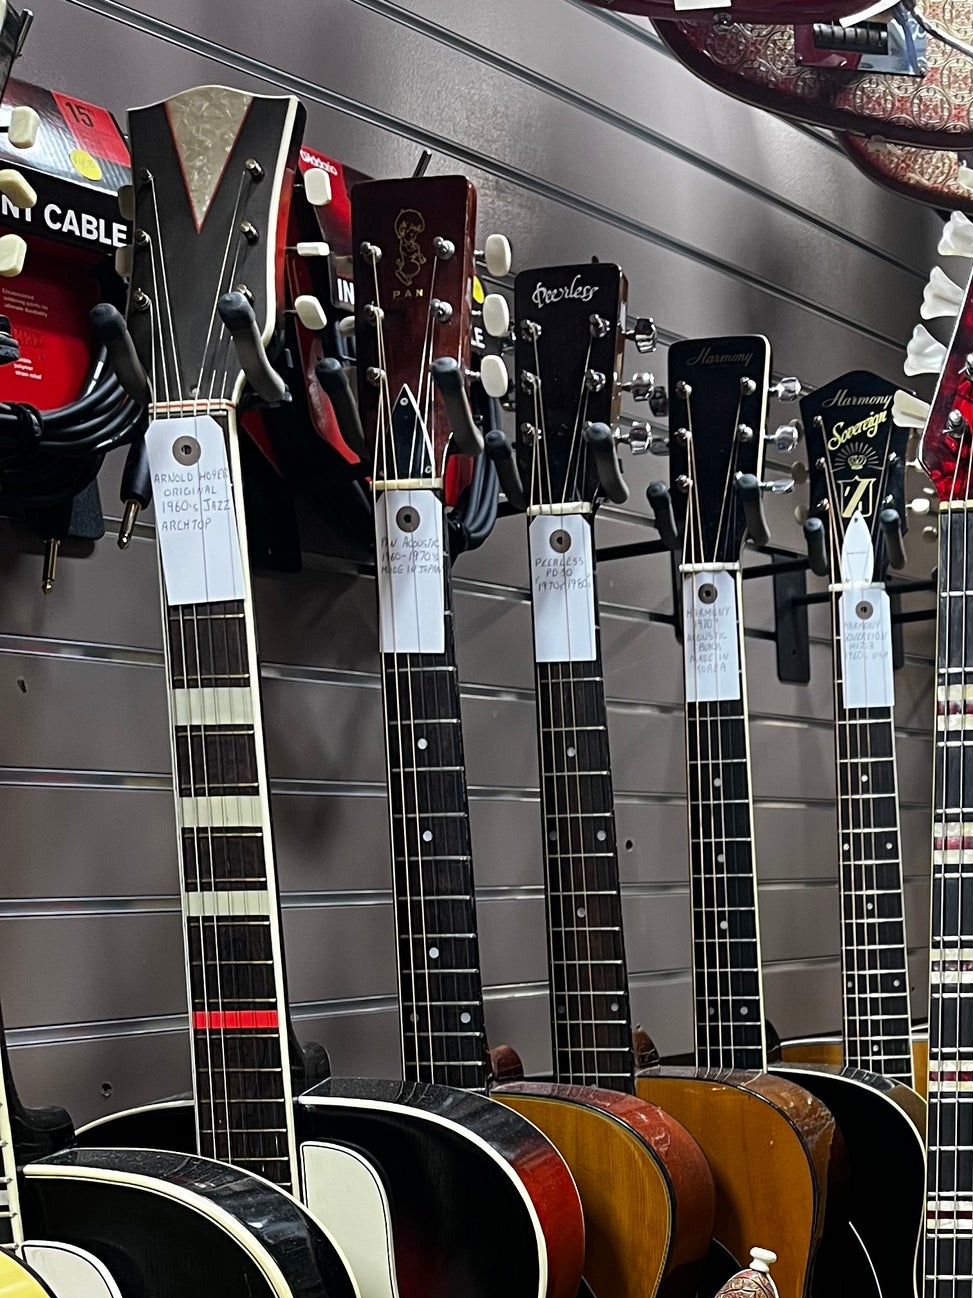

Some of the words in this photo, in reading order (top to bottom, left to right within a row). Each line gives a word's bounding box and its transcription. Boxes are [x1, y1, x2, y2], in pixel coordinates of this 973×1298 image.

[44, 203, 128, 248] CABLE
[392, 288, 424, 299] PAN
[532, 274, 600, 308] Peerless
[686, 346, 754, 367] Harmony
[822, 389, 893, 410] Harmony
[827, 410, 888, 451] Sovereign
[154, 472, 194, 484] ARNOLD
[199, 467, 229, 481] HOYER
[163, 484, 217, 497] ORIGINAL
[202, 498, 231, 512] JAZZ
